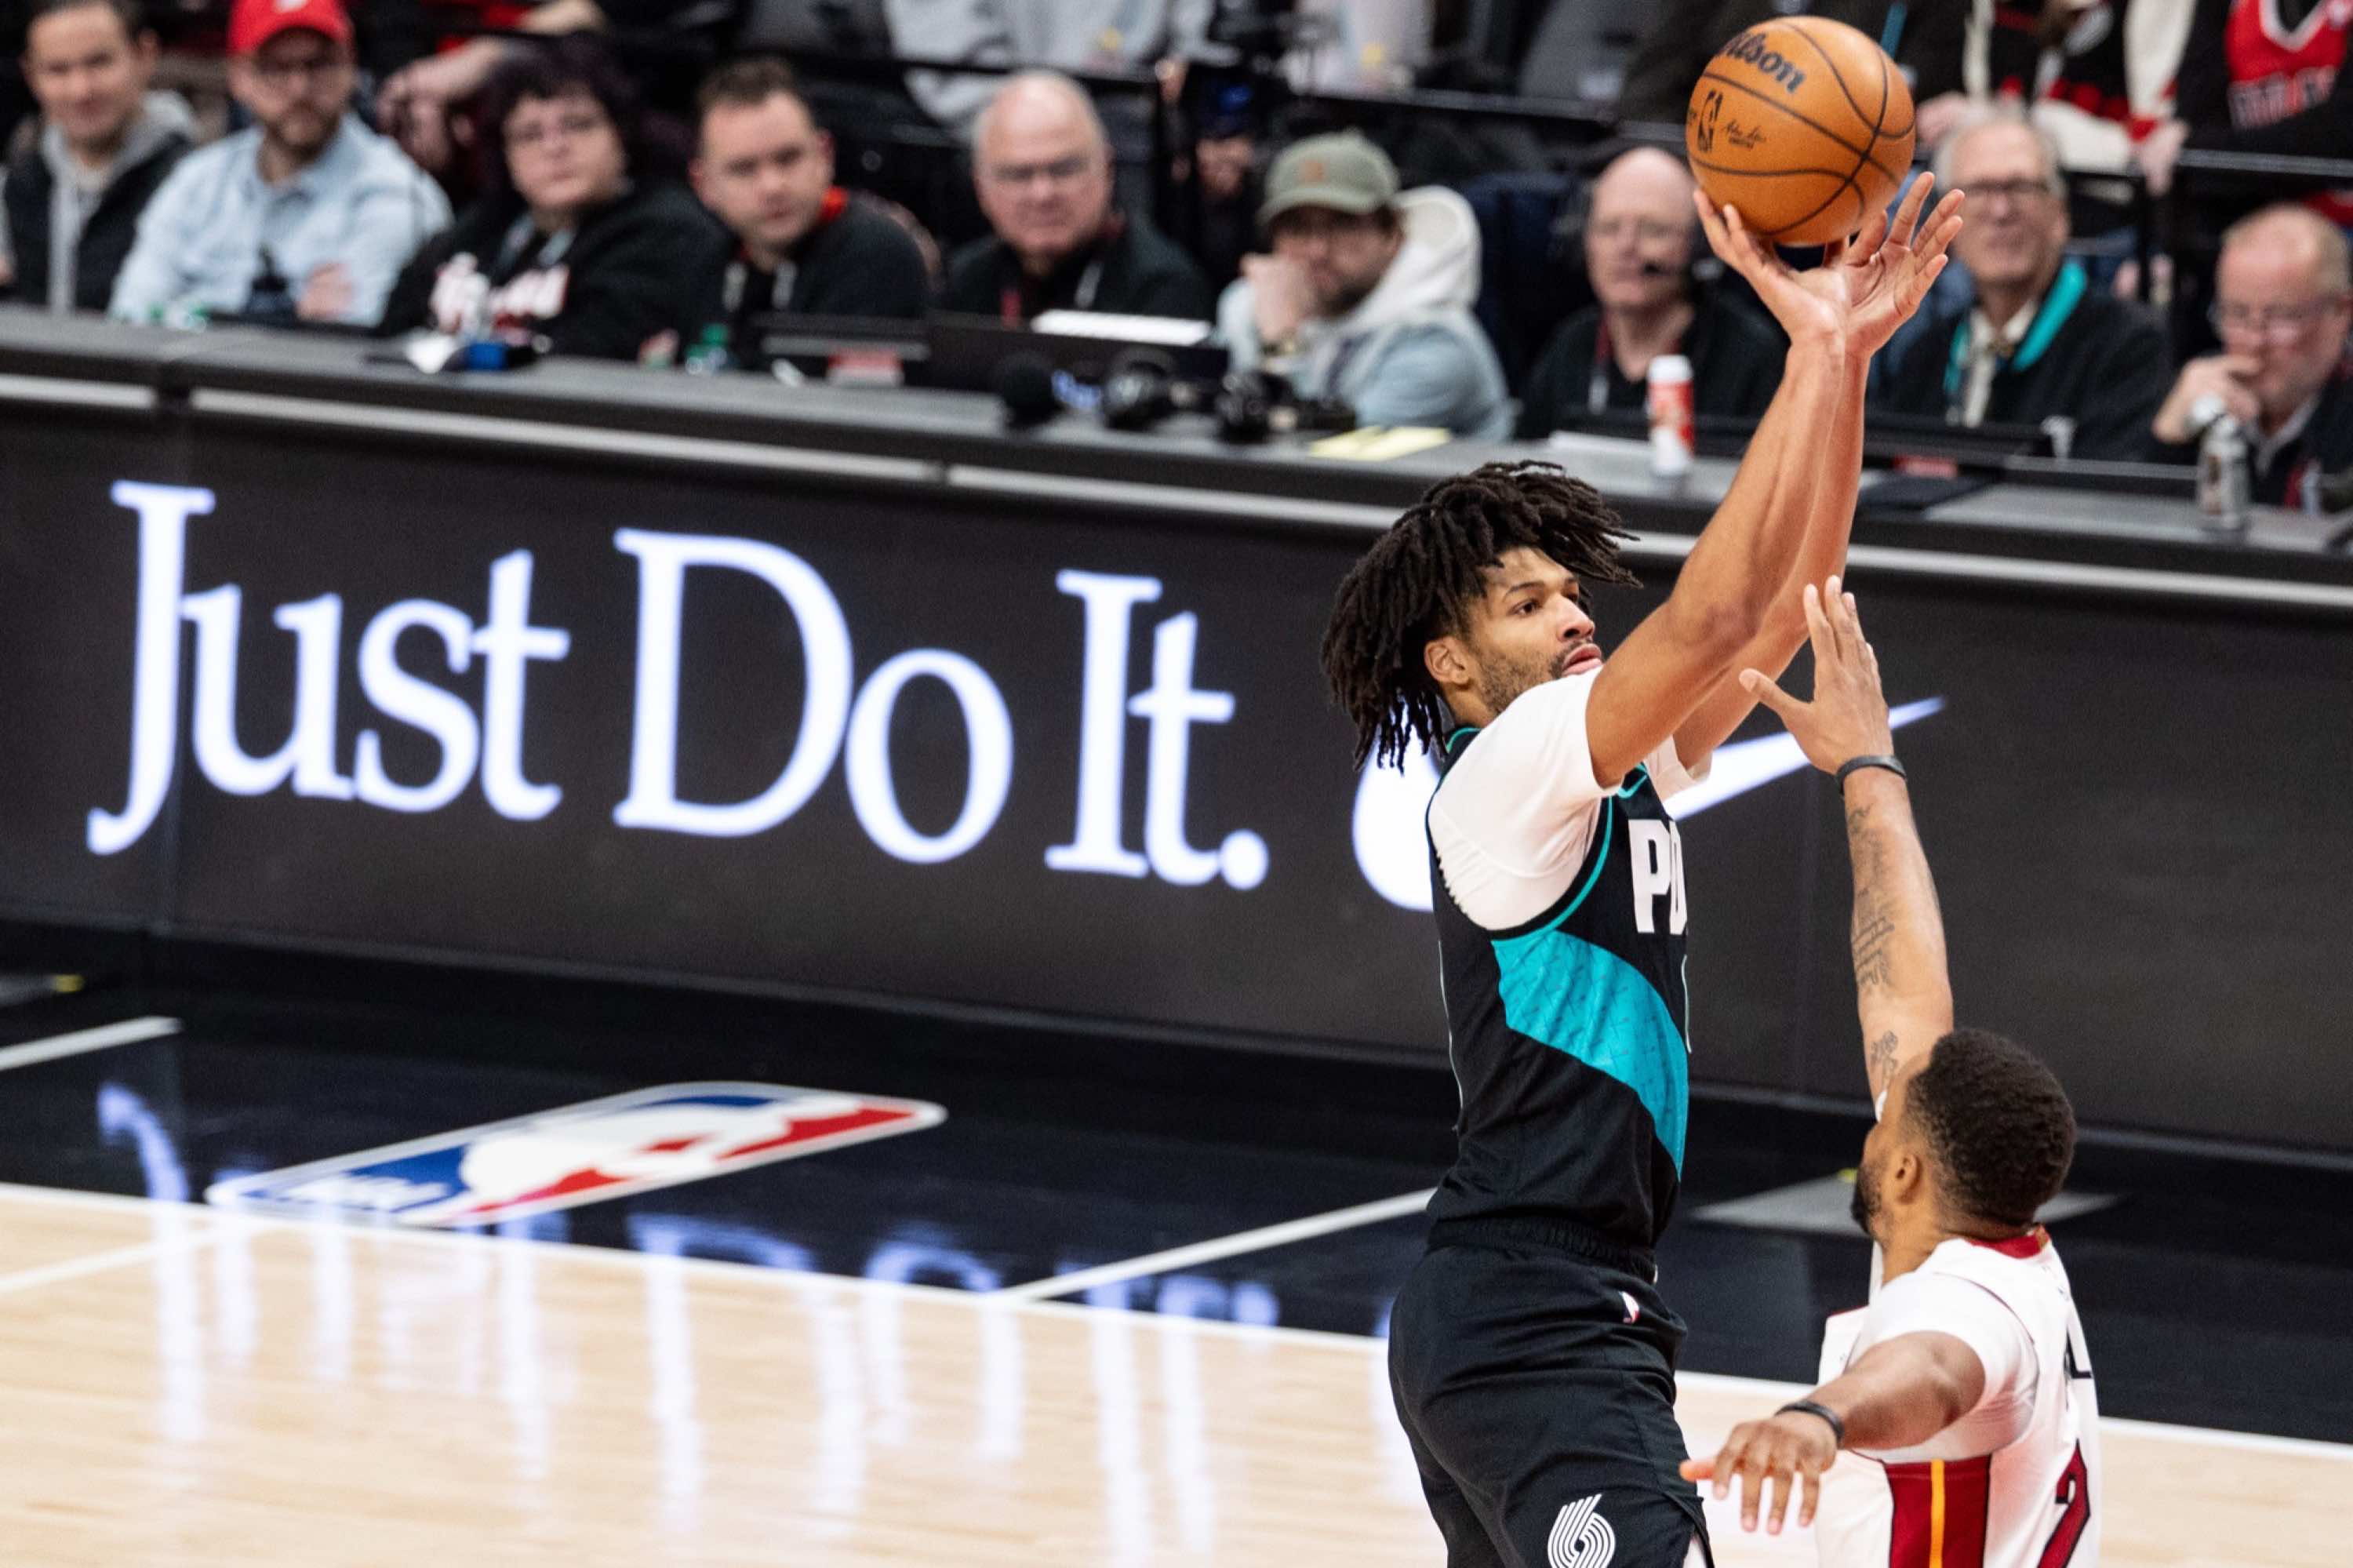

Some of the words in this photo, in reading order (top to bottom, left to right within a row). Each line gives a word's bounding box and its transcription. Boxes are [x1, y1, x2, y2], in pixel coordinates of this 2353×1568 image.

[87, 480, 570, 855] Just
[613, 529, 1013, 864] Do
[1045, 569, 1268, 890] It.
